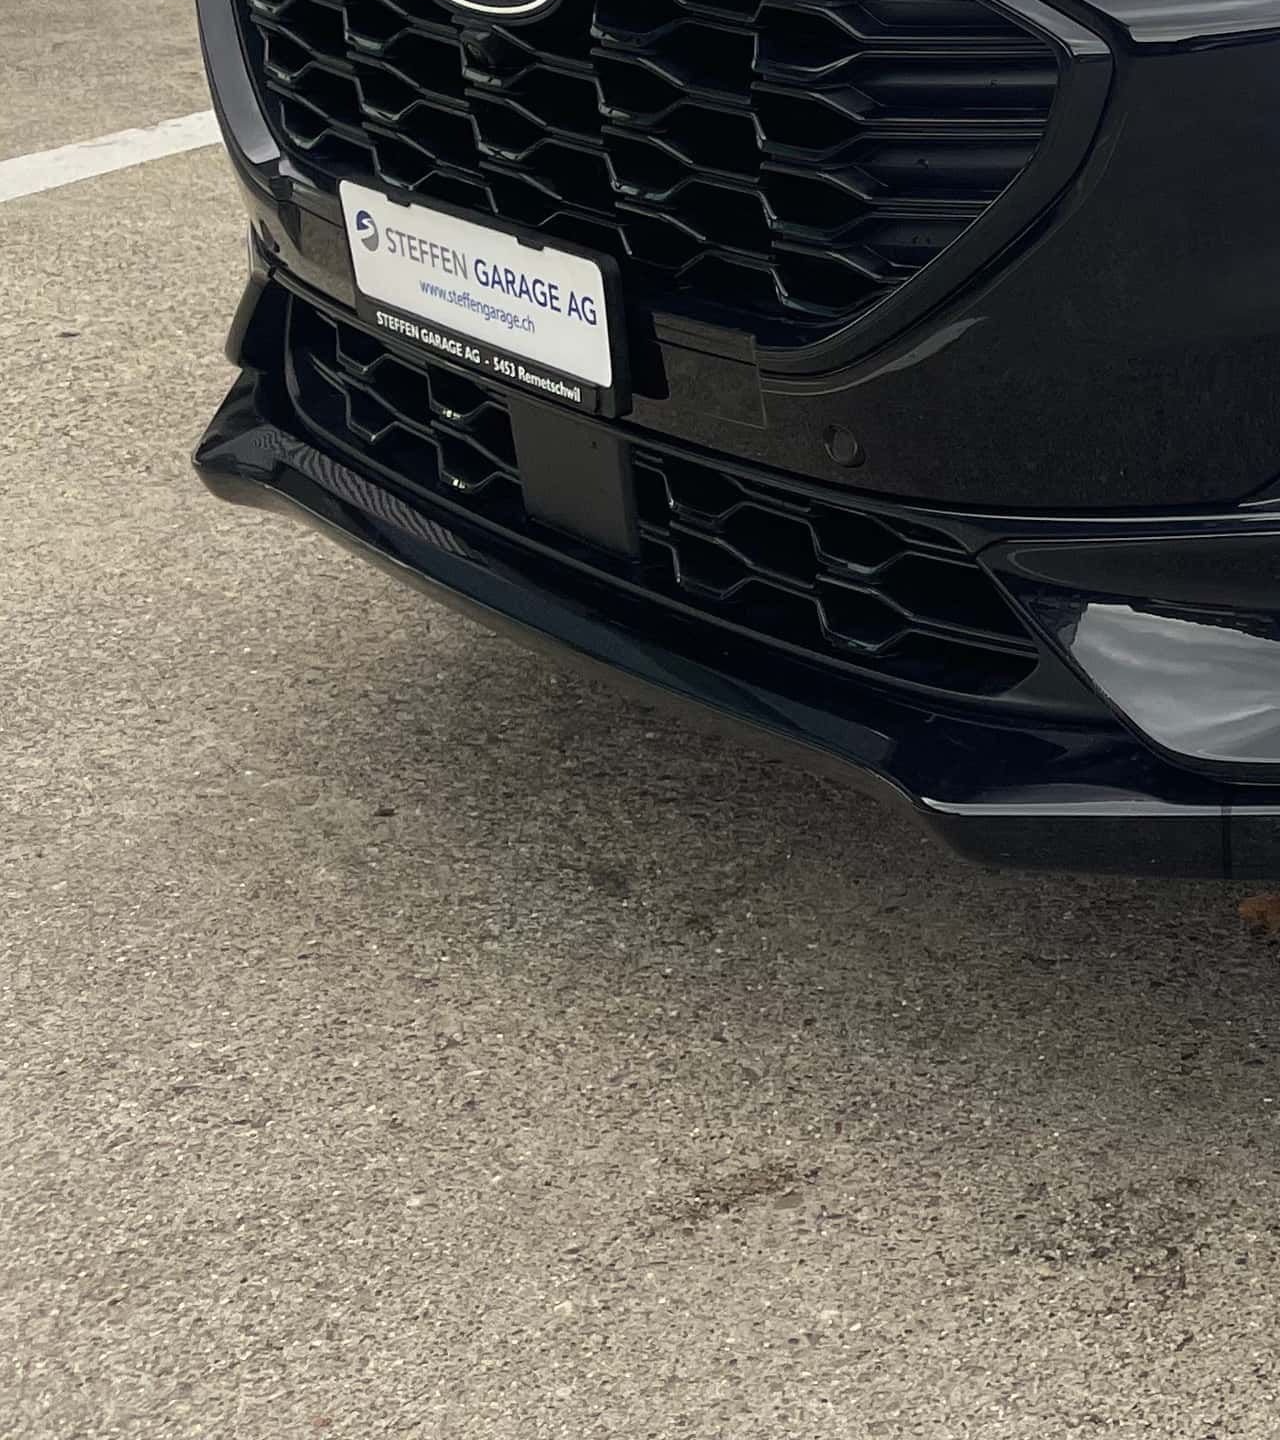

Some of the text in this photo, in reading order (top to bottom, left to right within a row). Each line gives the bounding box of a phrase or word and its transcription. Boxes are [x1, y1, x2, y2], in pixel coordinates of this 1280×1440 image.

[385, 226, 597, 326] STEFFEN GARAGE AG
[419, 280, 535, 334] www.steffengarage.ch
[376, 310, 419, 339] STEFFEN
[420, 328, 463, 358] GARAGE
[464, 346, 481, 364] AG
[493, 356, 516, 377] 5453
[518, 365, 582, 403] Remetschwil
